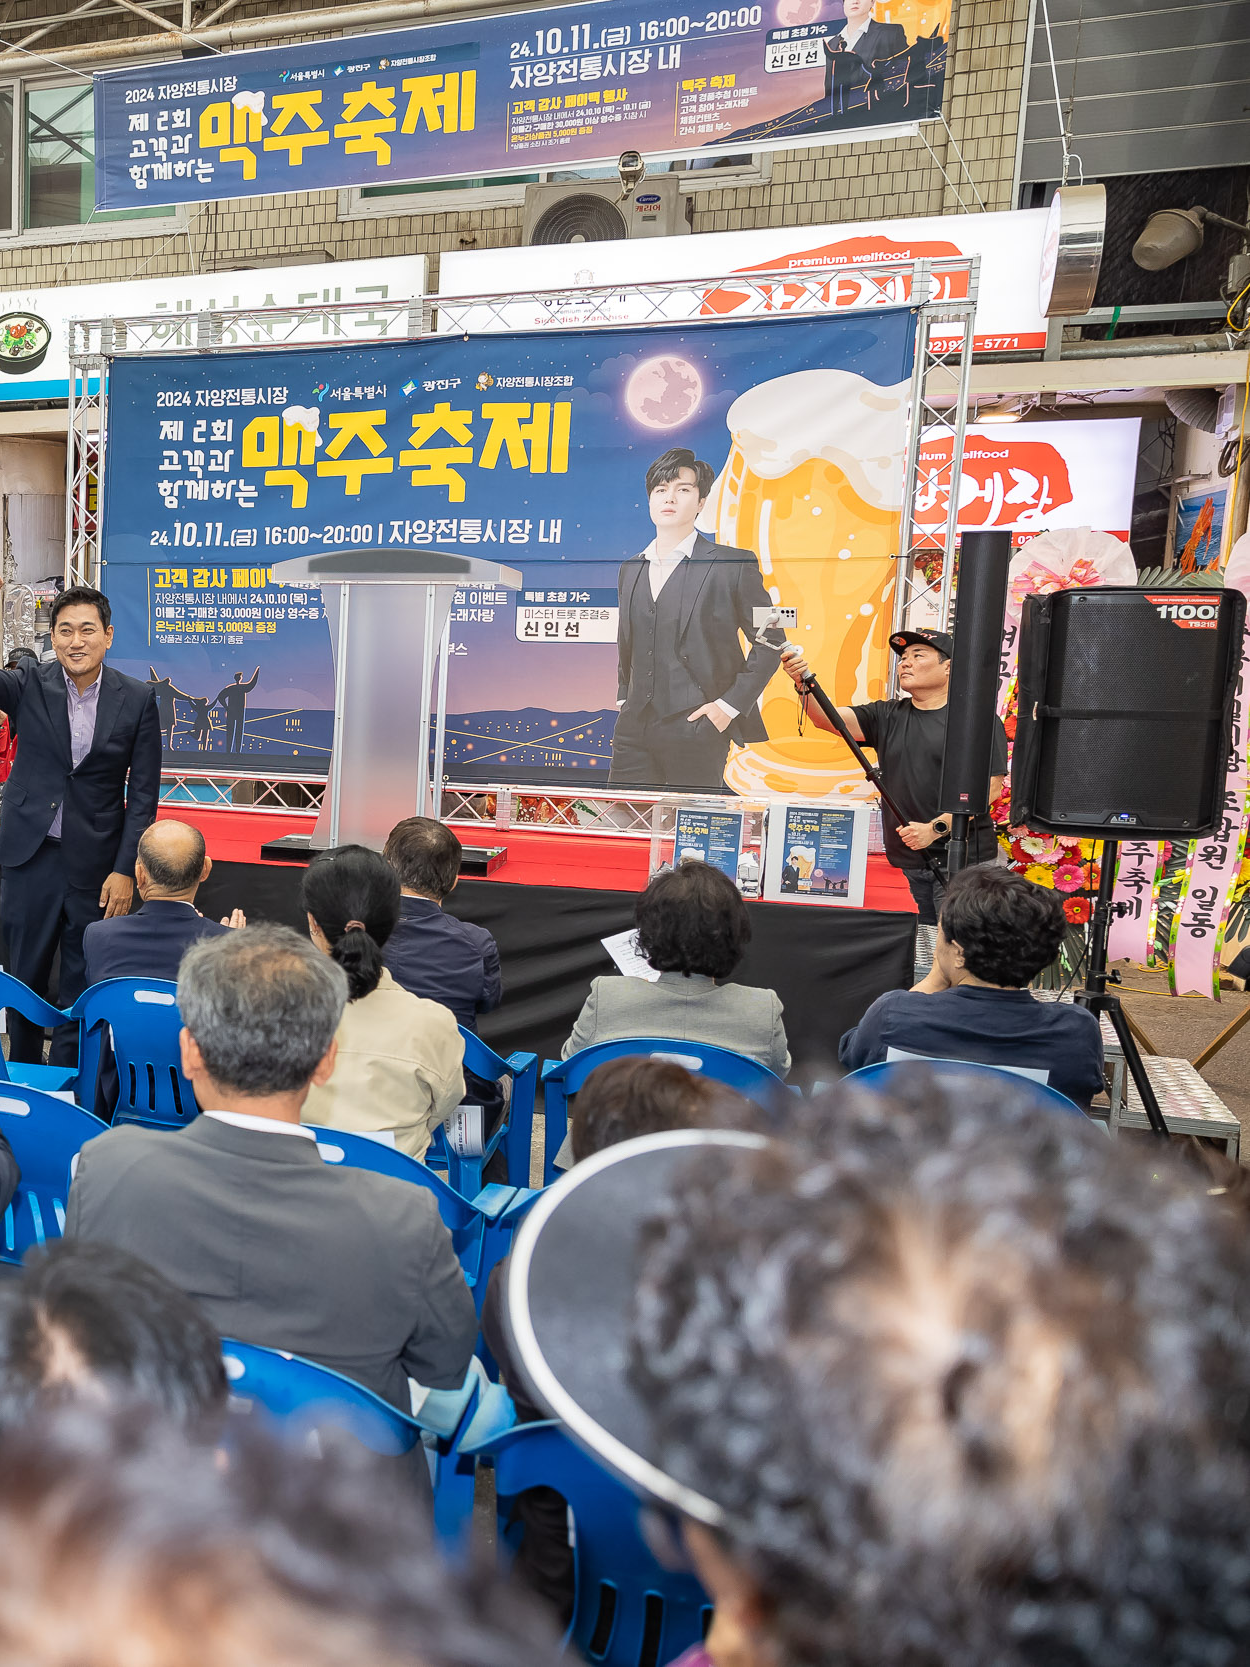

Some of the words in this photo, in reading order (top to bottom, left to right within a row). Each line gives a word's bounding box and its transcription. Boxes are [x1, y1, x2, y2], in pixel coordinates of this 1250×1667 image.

[638, 4, 762, 43] 16:00~20:00
[289, 68, 325, 82] 서울특별시
[347, 63, 371, 74] 광진구
[509, 49, 652, 90] 자양전통시장
[657, 45, 681, 71] 내
[125, 89, 154, 105] 2024
[157, 76, 238, 101] 자양전통시장
[511, 100, 536, 116] 고객
[538, 96, 562, 111] 감사
[129, 134, 193, 163] 고객과
[128, 159, 215, 190] 함께하는
[635, 204, 661, 212] 캐리어
[788, 254, 848, 269] premium
[852, 249, 911, 265] wellfood
[422, 378, 462, 393] 광진구
[495, 374, 575, 389] 자양전통시장조합
[157, 391, 192, 407] 2024
[195, 386, 289, 407] 자양전통시장
[329, 383, 388, 400] 서울특별시
[158, 419, 184, 443] 제
[158, 448, 235, 479] 고객과
[952, 449, 1010, 461] ellfood
[157, 479, 259, 509] 함께하는
[264, 523, 373, 547] 16:00~20:00
[388, 519, 533, 547] 자양전통시장
[537, 518, 563, 546] 내
[154, 568, 188, 588] 고객
[192, 568, 228, 588] 감사
[155, 592, 216, 605] 자양전통시장
[217, 592, 248, 605] 내에서
[250, 593, 288, 605] 24.10.10
[289, 593, 308, 605] (목)
[469, 591, 508, 605] 이벤트
[524, 591, 544, 603] 특별
[546, 591, 568, 603] 초청
[569, 591, 591, 603] 가수
[155, 606, 185, 619] 이틀간
[187, 606, 218, 619] 구매한
[220, 606, 262, 620] 30,000원
[264, 606, 285, 619] 이상
[287, 606, 320, 619] 영수증
[524, 609, 554, 620] 미스터
[556, 609, 577, 620] 트롯
[579, 609, 610, 620] 준결승
[1156, 604, 1215, 620] 1100
[155, 620, 215, 633] 온누리상품권
[217, 620, 254, 633] 5,000원
[255, 620, 277, 633] 증정
[1180, 885, 1219, 939] 일동
